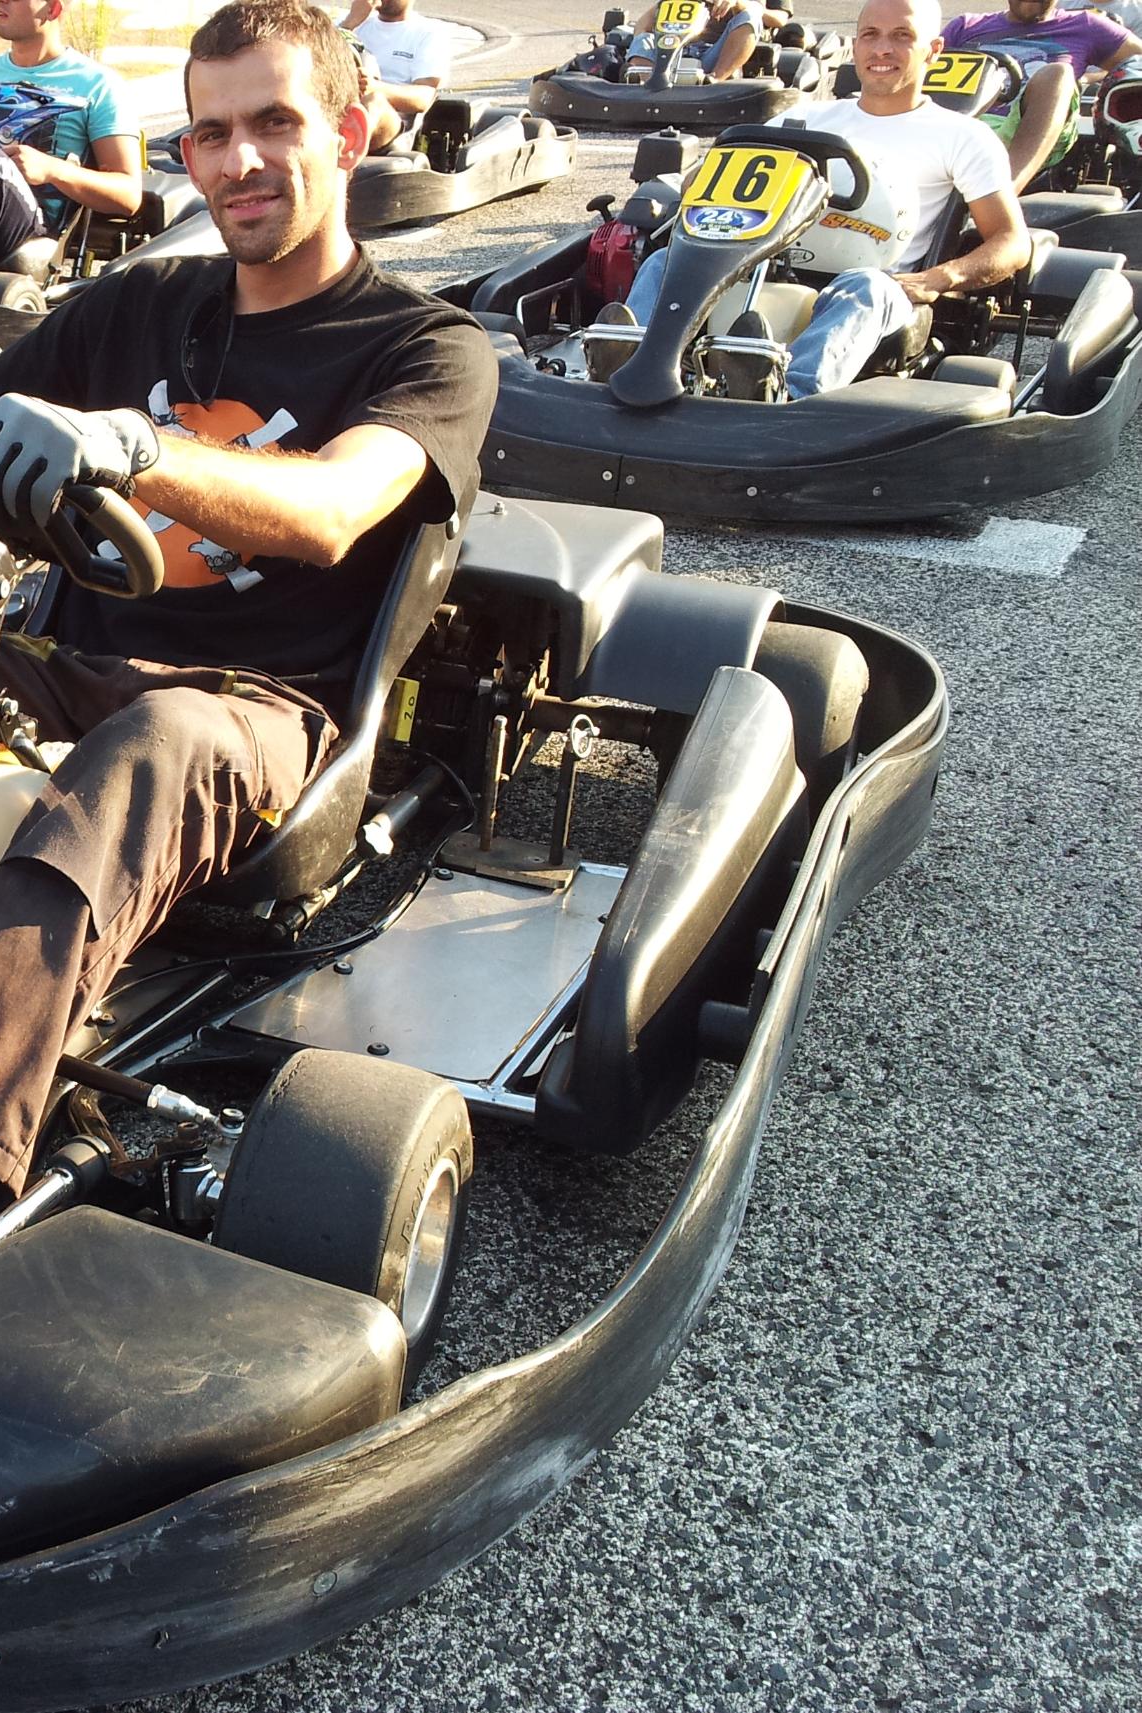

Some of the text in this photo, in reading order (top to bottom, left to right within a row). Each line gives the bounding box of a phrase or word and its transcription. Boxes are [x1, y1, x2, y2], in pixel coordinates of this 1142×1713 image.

[665, 3, 694, 21] 18
[922, 57, 984, 88] 27
[694, 150, 777, 203] 16
[701, 209, 734, 224] 24
